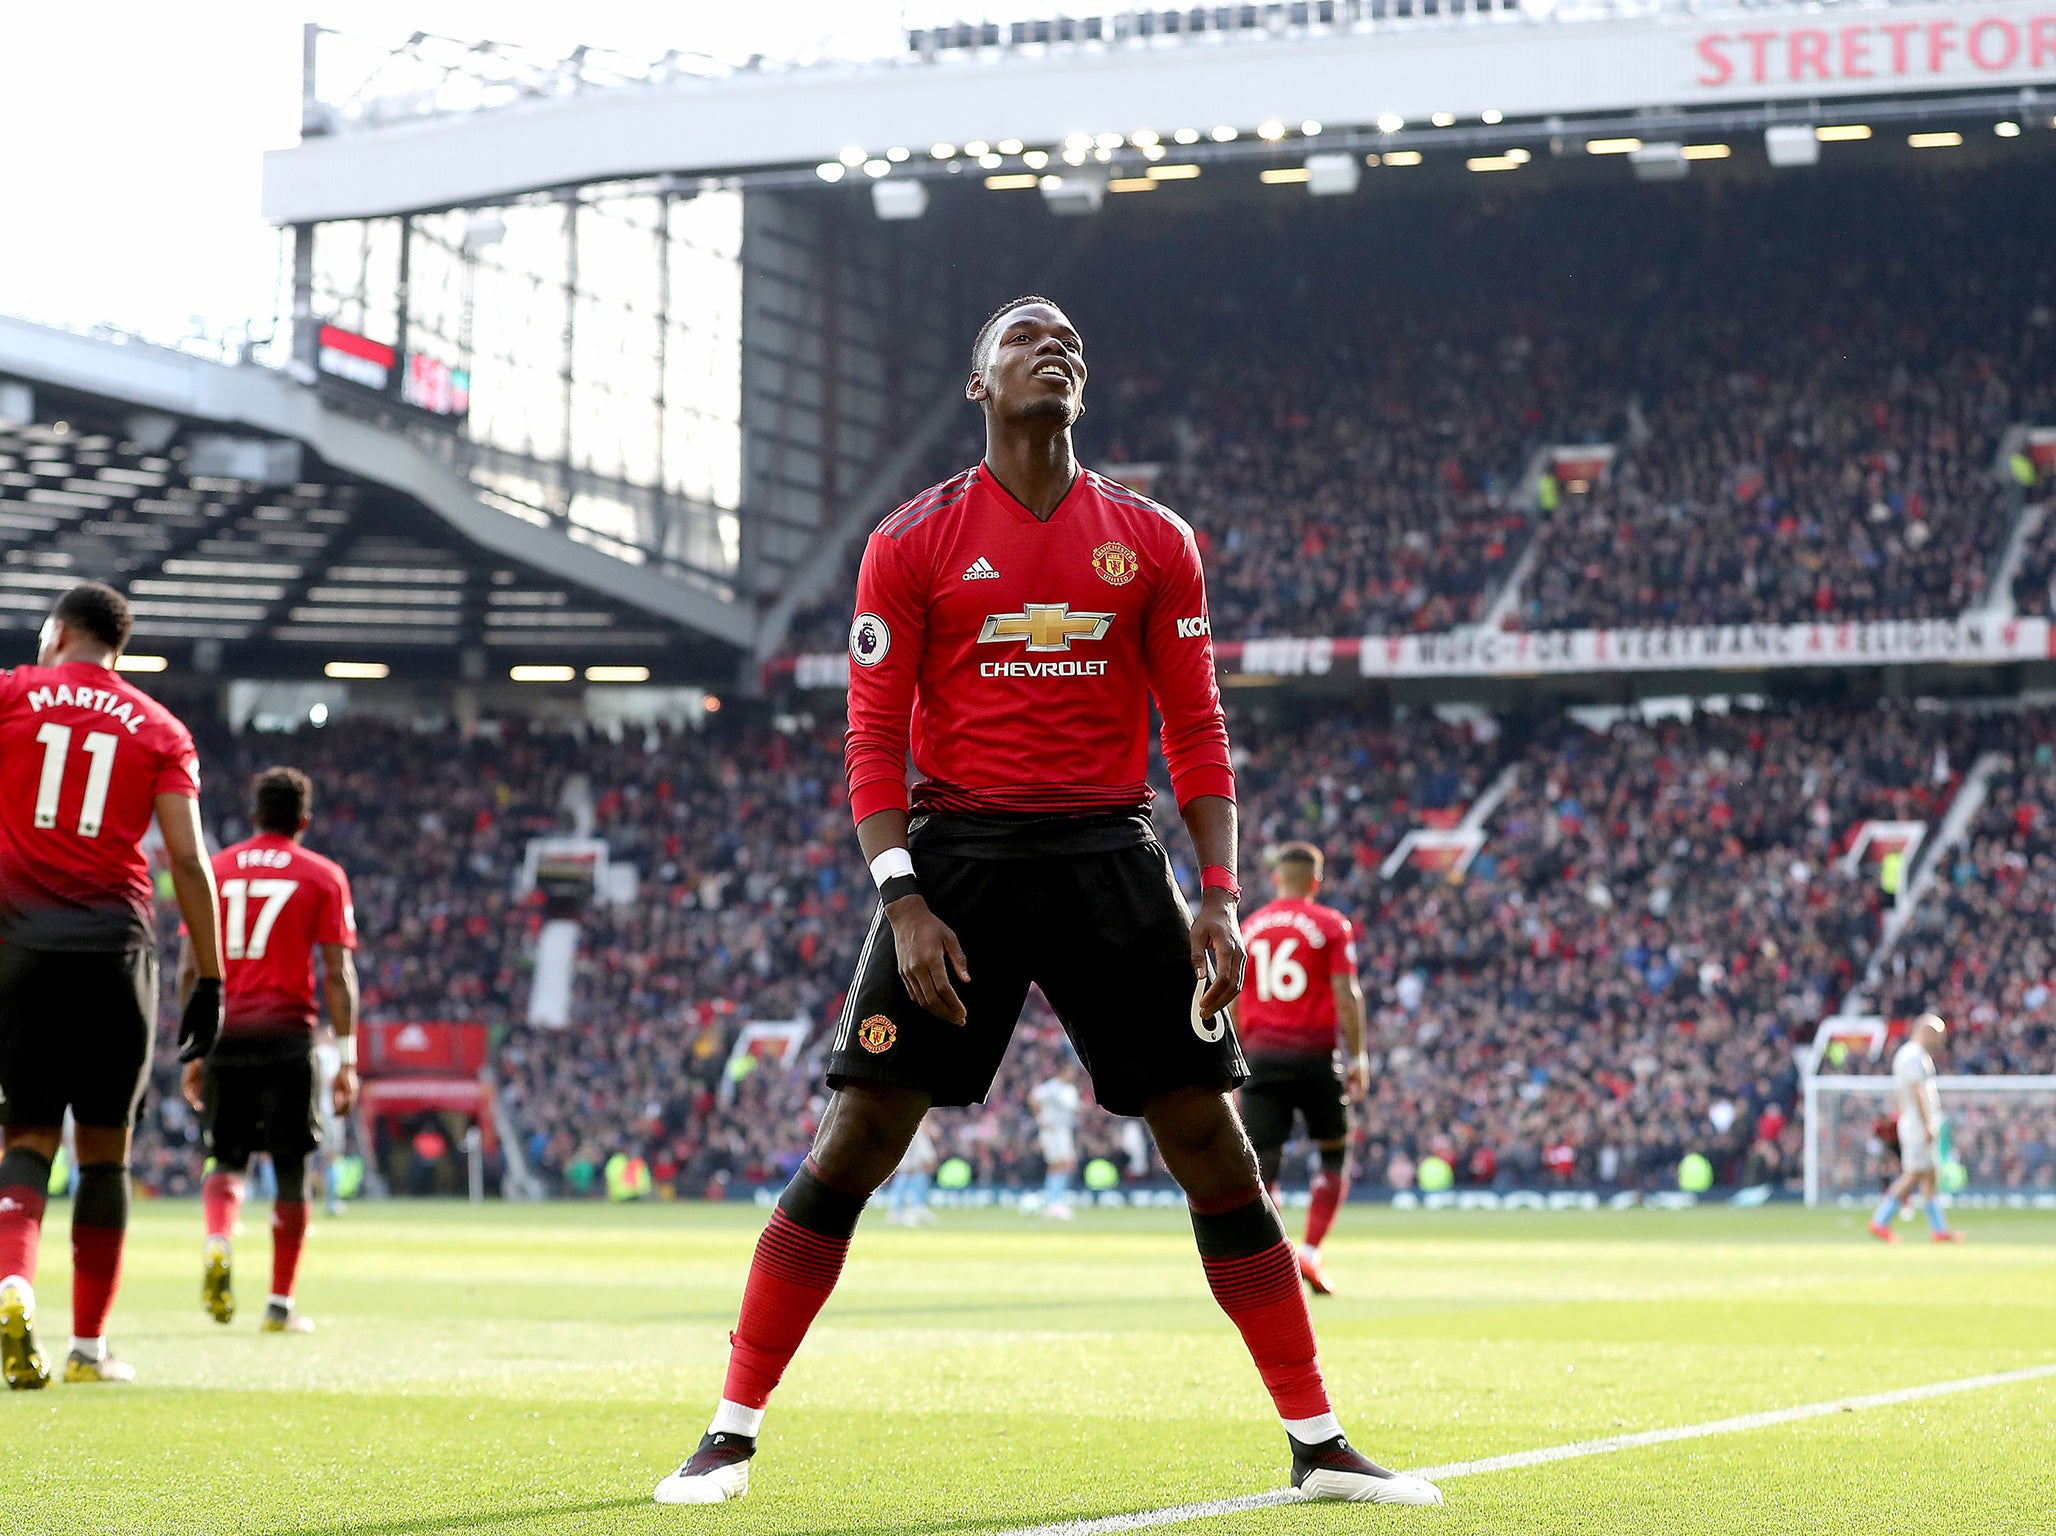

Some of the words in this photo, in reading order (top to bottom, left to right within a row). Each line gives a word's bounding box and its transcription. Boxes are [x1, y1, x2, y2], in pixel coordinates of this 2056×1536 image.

[962, 570, 1000, 581] adidas
[1103, 573, 1129, 583] UNITED
[1177, 616, 1211, 638] KOH
[980, 659, 1108, 678] CHEVROLET
[27, 683, 147, 735] MARTIAL
[34, 722, 119, 838] 11
[220, 879, 299, 960] 17
[1251, 937, 1308, 1003] 16
